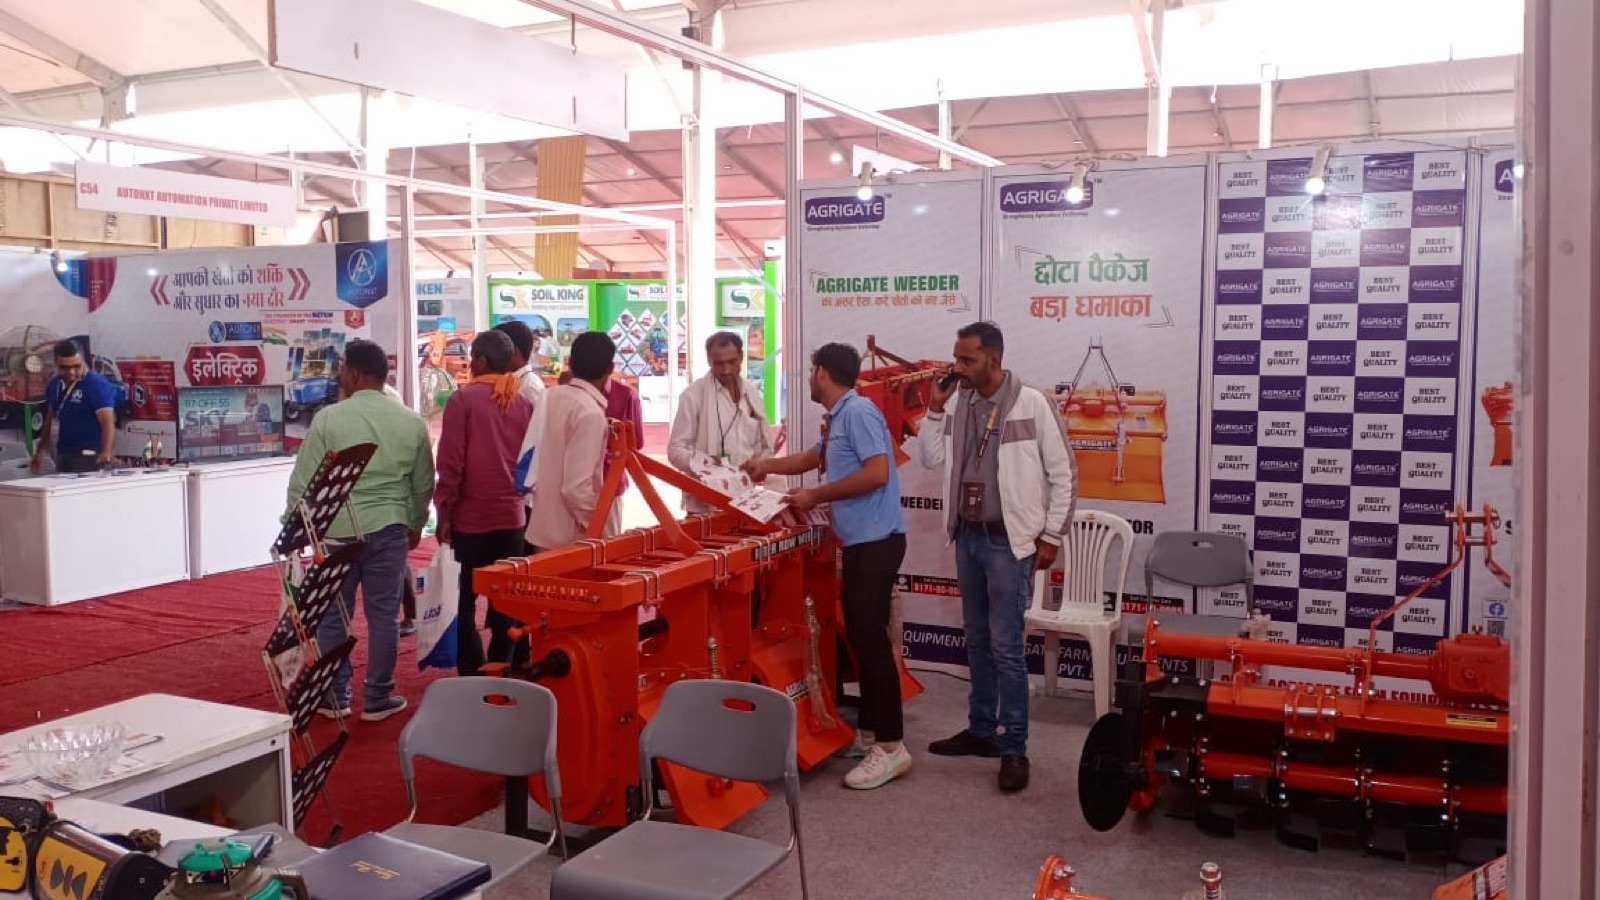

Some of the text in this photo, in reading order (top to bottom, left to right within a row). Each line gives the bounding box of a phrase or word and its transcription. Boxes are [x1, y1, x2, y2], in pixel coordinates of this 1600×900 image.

[1429, 162, 1450, 170] BEST
[1422, 170, 1456, 179] QUALITY
[1226, 178, 1258, 188] QUALITY
[1003, 187, 1091, 205] AGRIGAE
[156, 190, 208, 206] AUTOMATION
[209, 198, 239, 210] PRIVATE
[239, 200, 268, 213] LIMITED
[807, 203, 883, 218] AGRIGATE
[1278, 206, 1299, 214] BEST
[1272, 213, 1304, 222] QUALITY
[1425, 238, 1446, 246] BEST
[1418, 245, 1454, 254] QUALITY
[1224, 250, 1256, 259] QUALITY
[1035, 253, 1149, 285] छोटा पैकेज
[816, 275, 959, 293] AGRIGATE WEEDER
[1276, 278, 1296, 286] BEST
[1270, 286, 1302, 294] QUALITY
[1366, 284, 1401, 293] QUALITY
[531, 289, 584, 300] SOIL KING
[1030, 294, 1152, 322] बड़ा धमाका
[1322, 313, 1344, 321] BEST
[1422, 312, 1444, 320] BEST
[1222, 322, 1254, 331] QUALITY
[1315, 320, 1350, 330] QUALITY
[1414, 320, 1450, 330] QUALITY
[1370, 350, 1391, 358] BEST
[1268, 357, 1300, 366] QUALITY
[1364, 358, 1398, 367] QUALITY
[1220, 392, 1252, 400] QUALITY
[1419, 388, 1440, 396] BEST
[1314, 393, 1346, 402] QUALITY
[1412, 395, 1447, 404] QUALITY
[1264, 428, 1297, 437] QUALITY
[1360, 430, 1394, 440] QUALITY
[1224, 454, 1243, 462] BEST
[1318, 458, 1337, 466] BEST
[1218, 461, 1250, 470] QUALITY
[1310, 465, 1344, 474] QUALITY
[1416, 462, 1436, 470] BEST
[1408, 468, 1444, 478] QUALITY
[1262, 498, 1294, 508] QUALITY
[1364, 496, 1384, 504] BEST
[1357, 503, 1392, 512] QUALITY
[1308, 536, 1342, 545] QUALITY
[1412, 534, 1434, 542] BEST
[1404, 542, 1440, 551] QUALITY
[1266, 560, 1286, 568] BEST
[1260, 568, 1292, 576] QUALITY
[1361, 568, 1382, 576] BEST
[1354, 576, 1389, 584] QUALITY
[1214, 599, 1246, 608] QUALITY
[1305, 606, 1338, 616] QUALITY
[1409, 607, 1430, 615] BEST
[1402, 614, 1437, 624] QUALITY
[903, 630, 968, 648] QUIPMENT
[1058, 663, 1085, 677] PVT.
